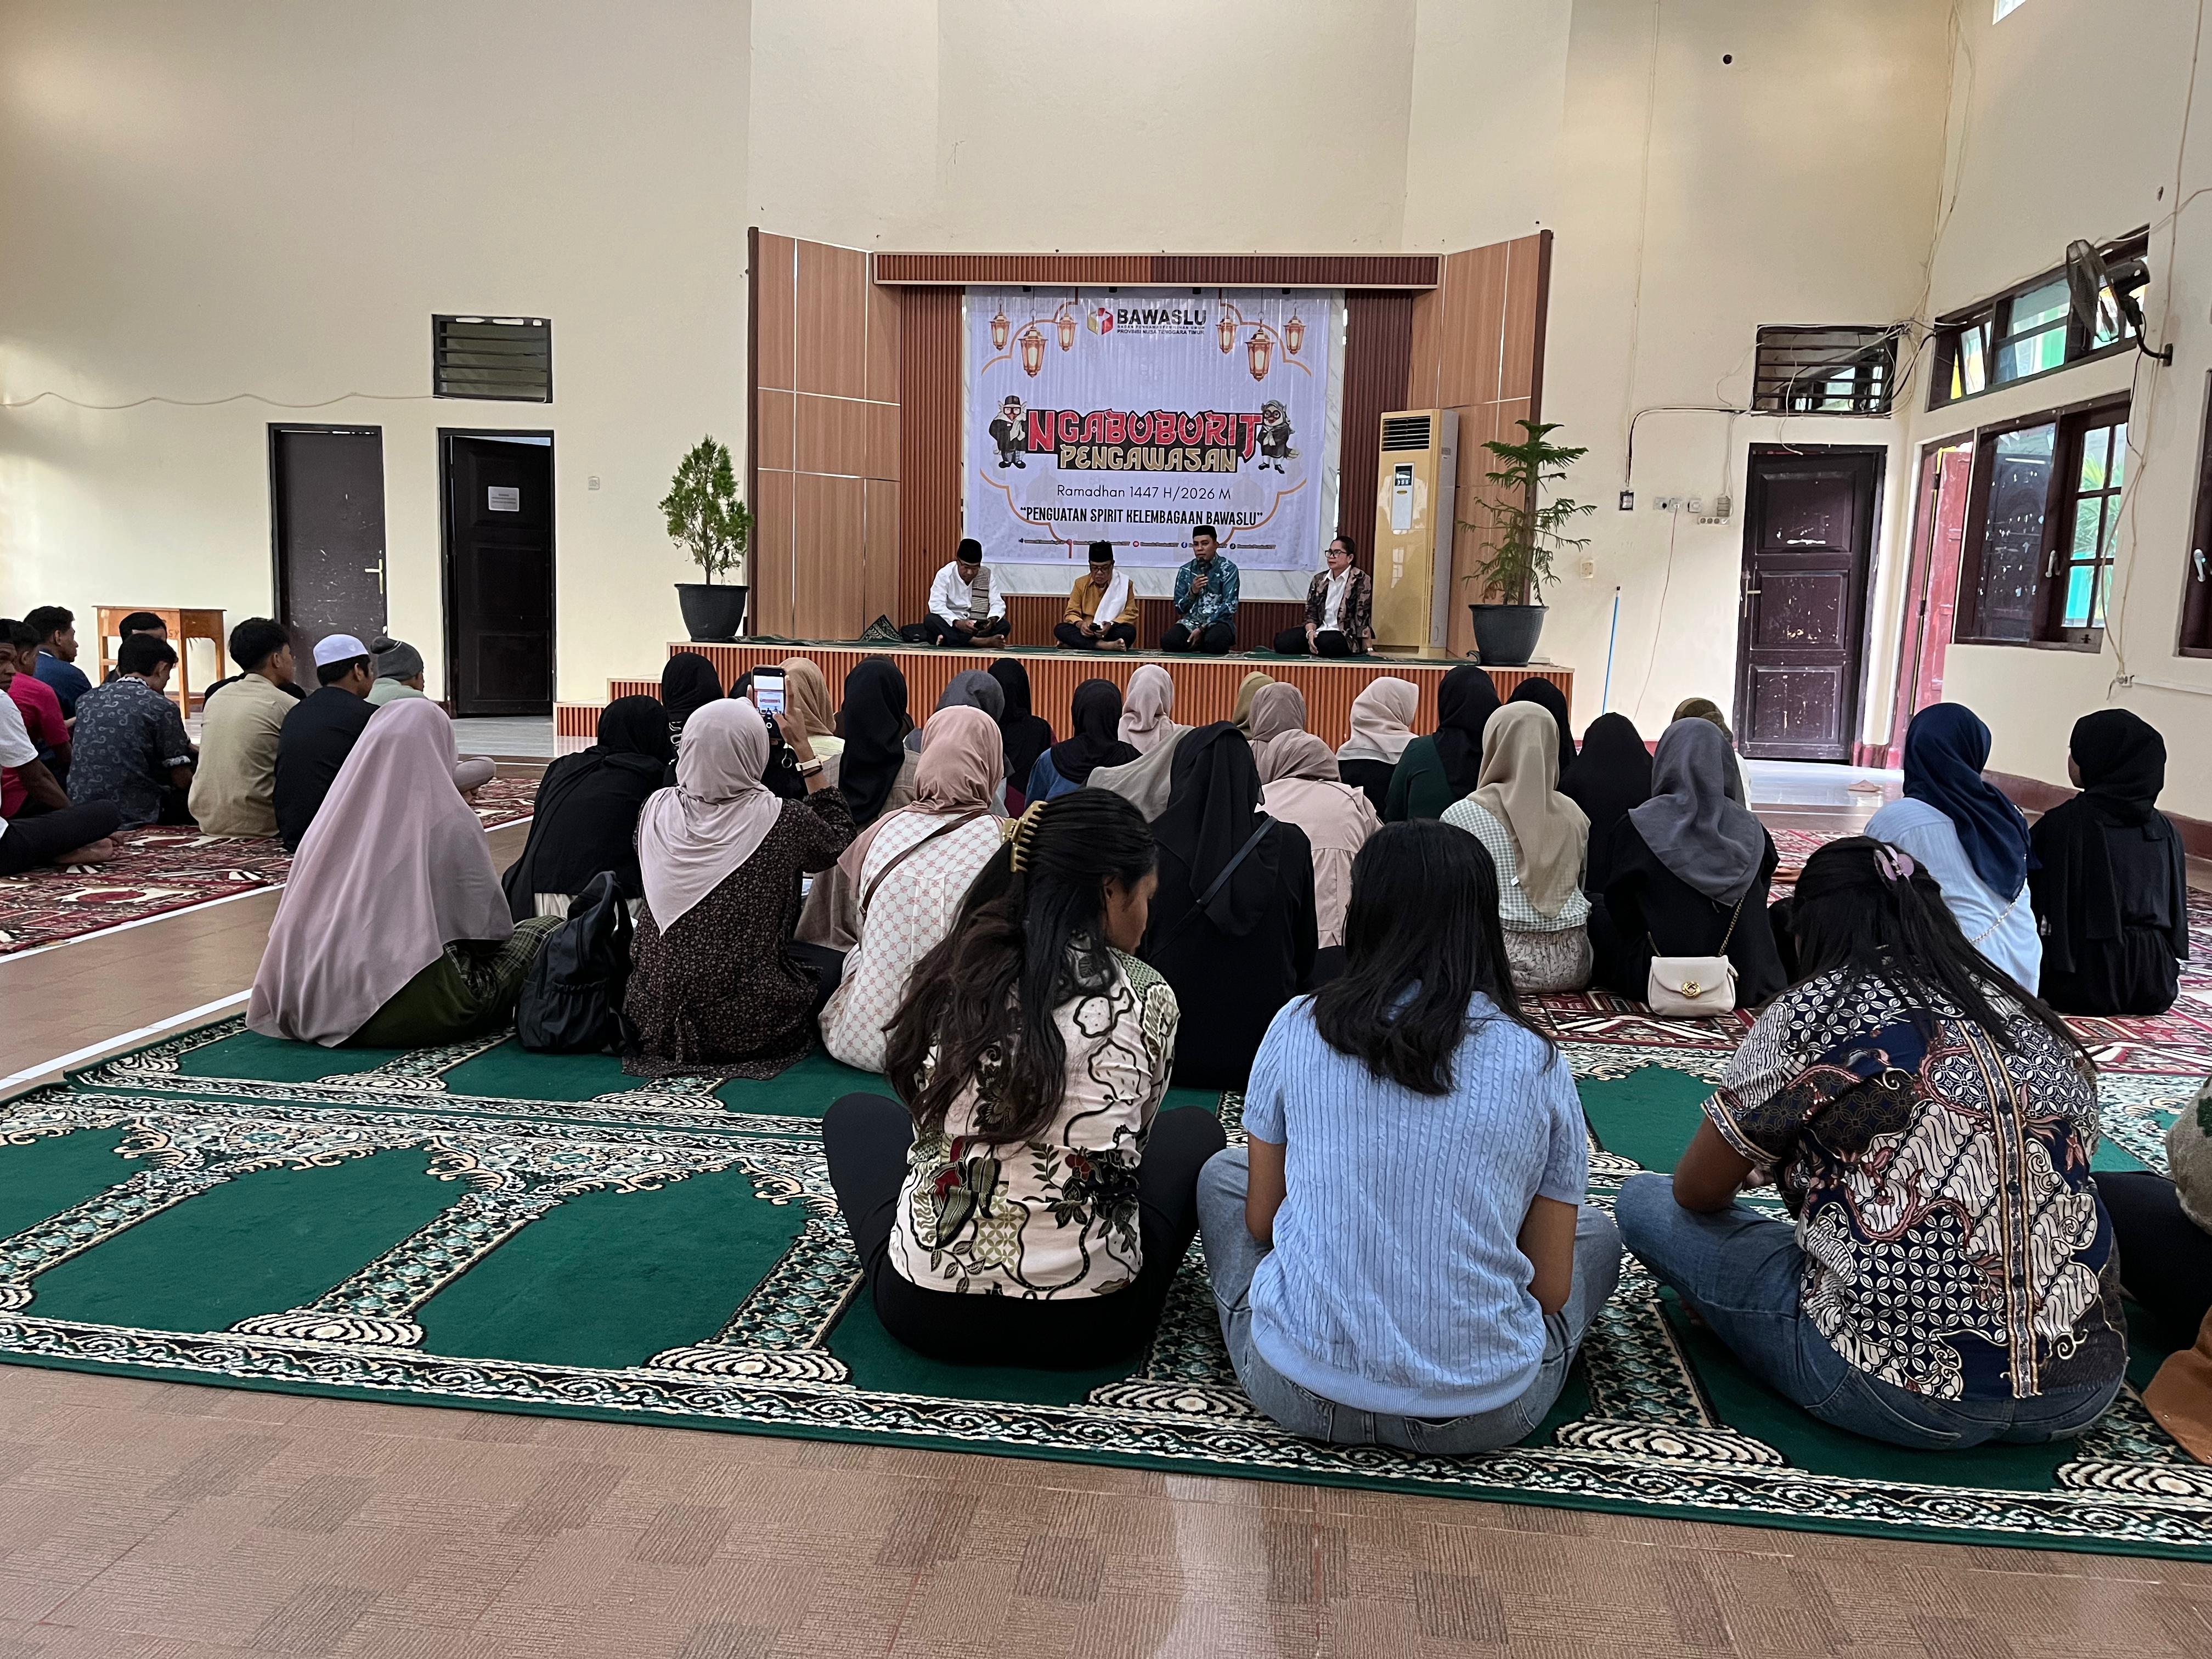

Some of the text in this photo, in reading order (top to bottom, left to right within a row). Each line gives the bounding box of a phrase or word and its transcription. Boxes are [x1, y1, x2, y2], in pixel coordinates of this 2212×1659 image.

[1117, 309, 1206, 325] BAWASLU
[1028, 409, 1262, 459] NGABUBURIT
[1060, 444, 1236, 472] PENGAWASAN
[1057, 484, 1231, 501] Ramadhan 1447 H/2026 M
[1020, 506, 1263, 526] “PENGUATAN SPIRIT KELEMBAGAAN BAWASLU”
